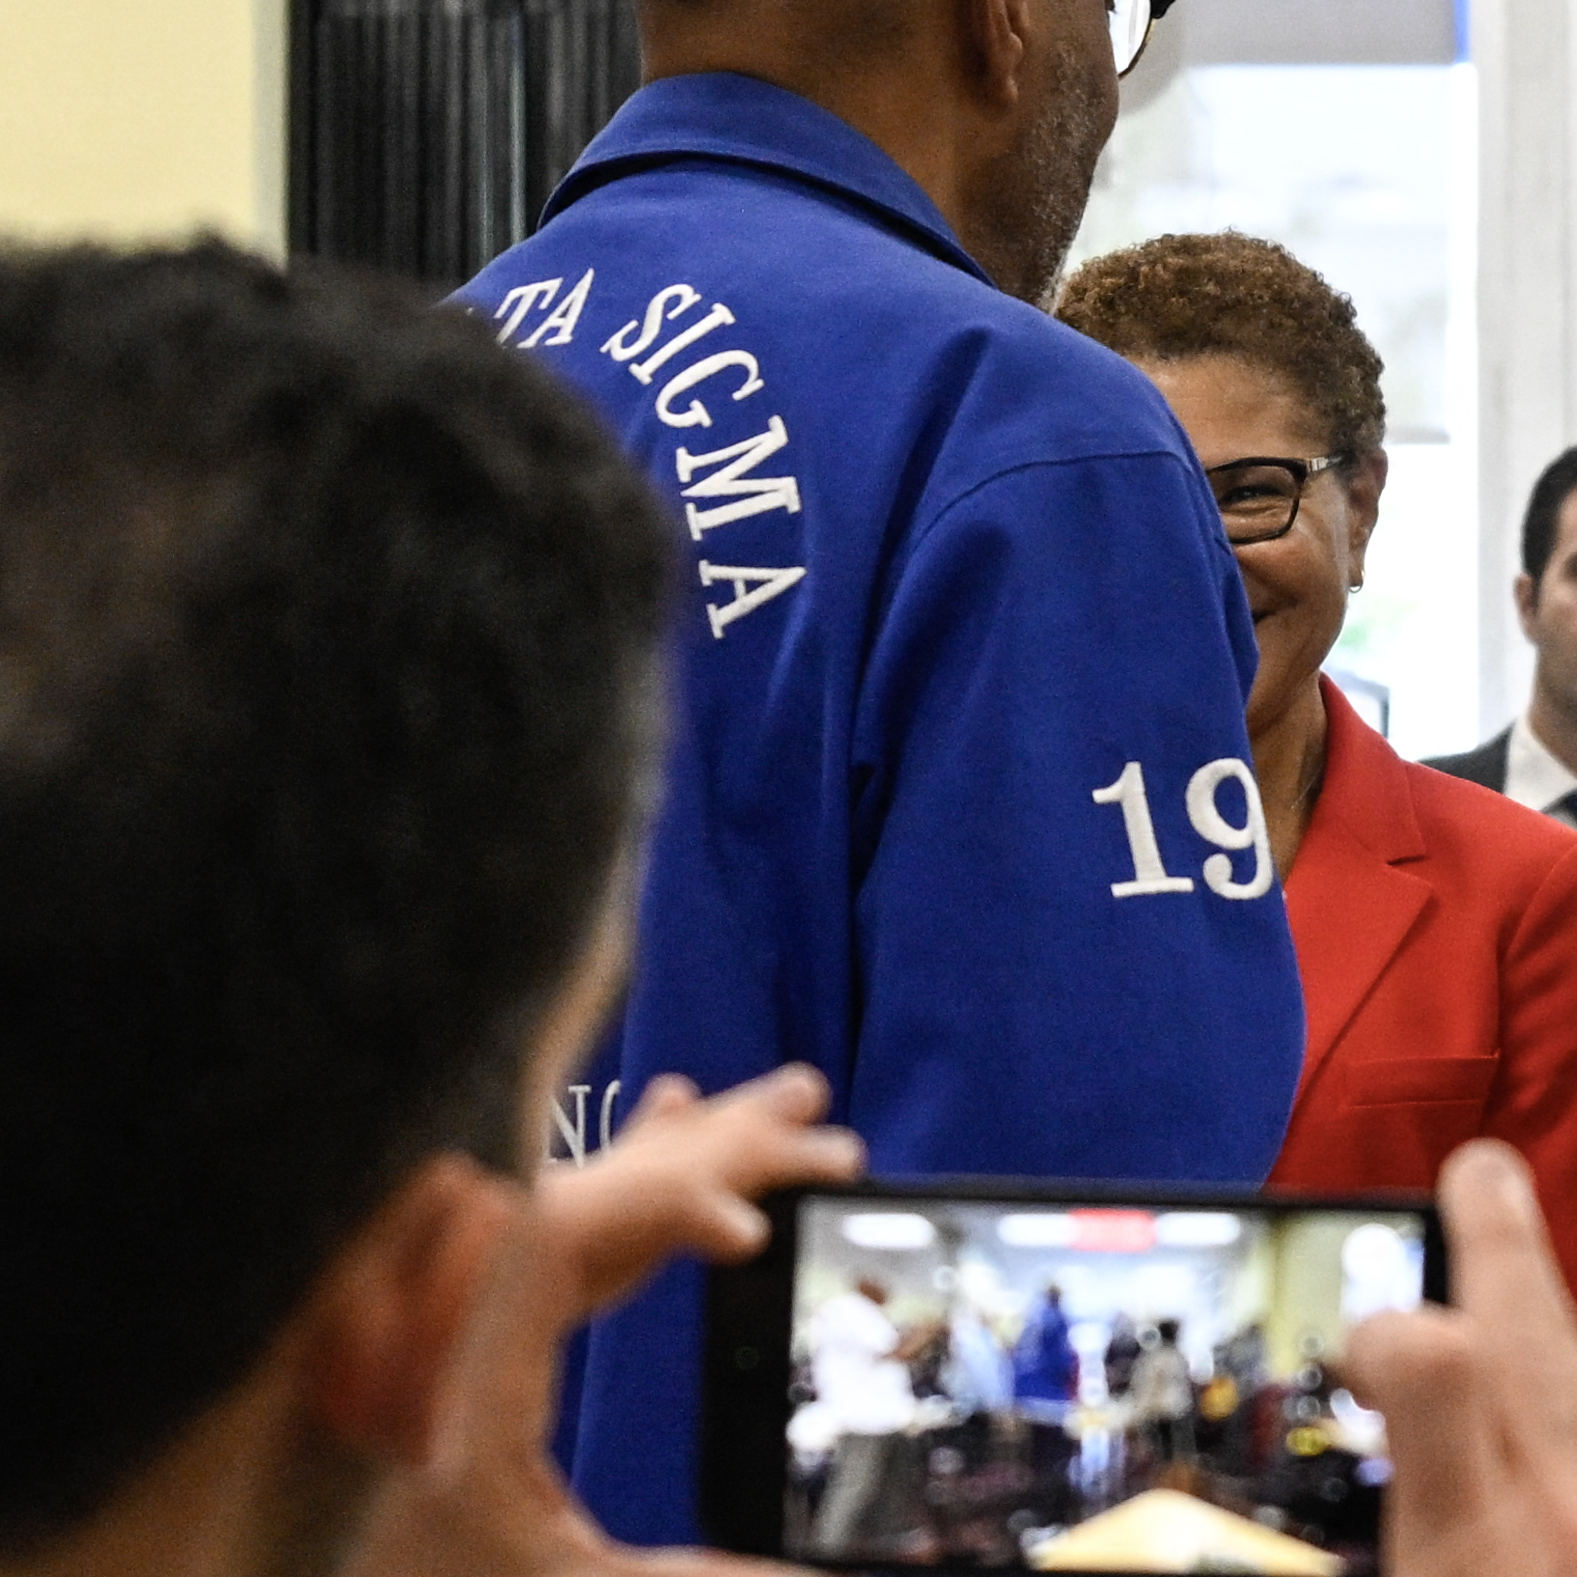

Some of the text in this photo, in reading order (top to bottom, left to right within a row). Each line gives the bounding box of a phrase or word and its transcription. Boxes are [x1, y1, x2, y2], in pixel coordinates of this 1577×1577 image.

[466, 268, 808, 640] TA SIGMA
[1092, 757, 1273, 900] 19
